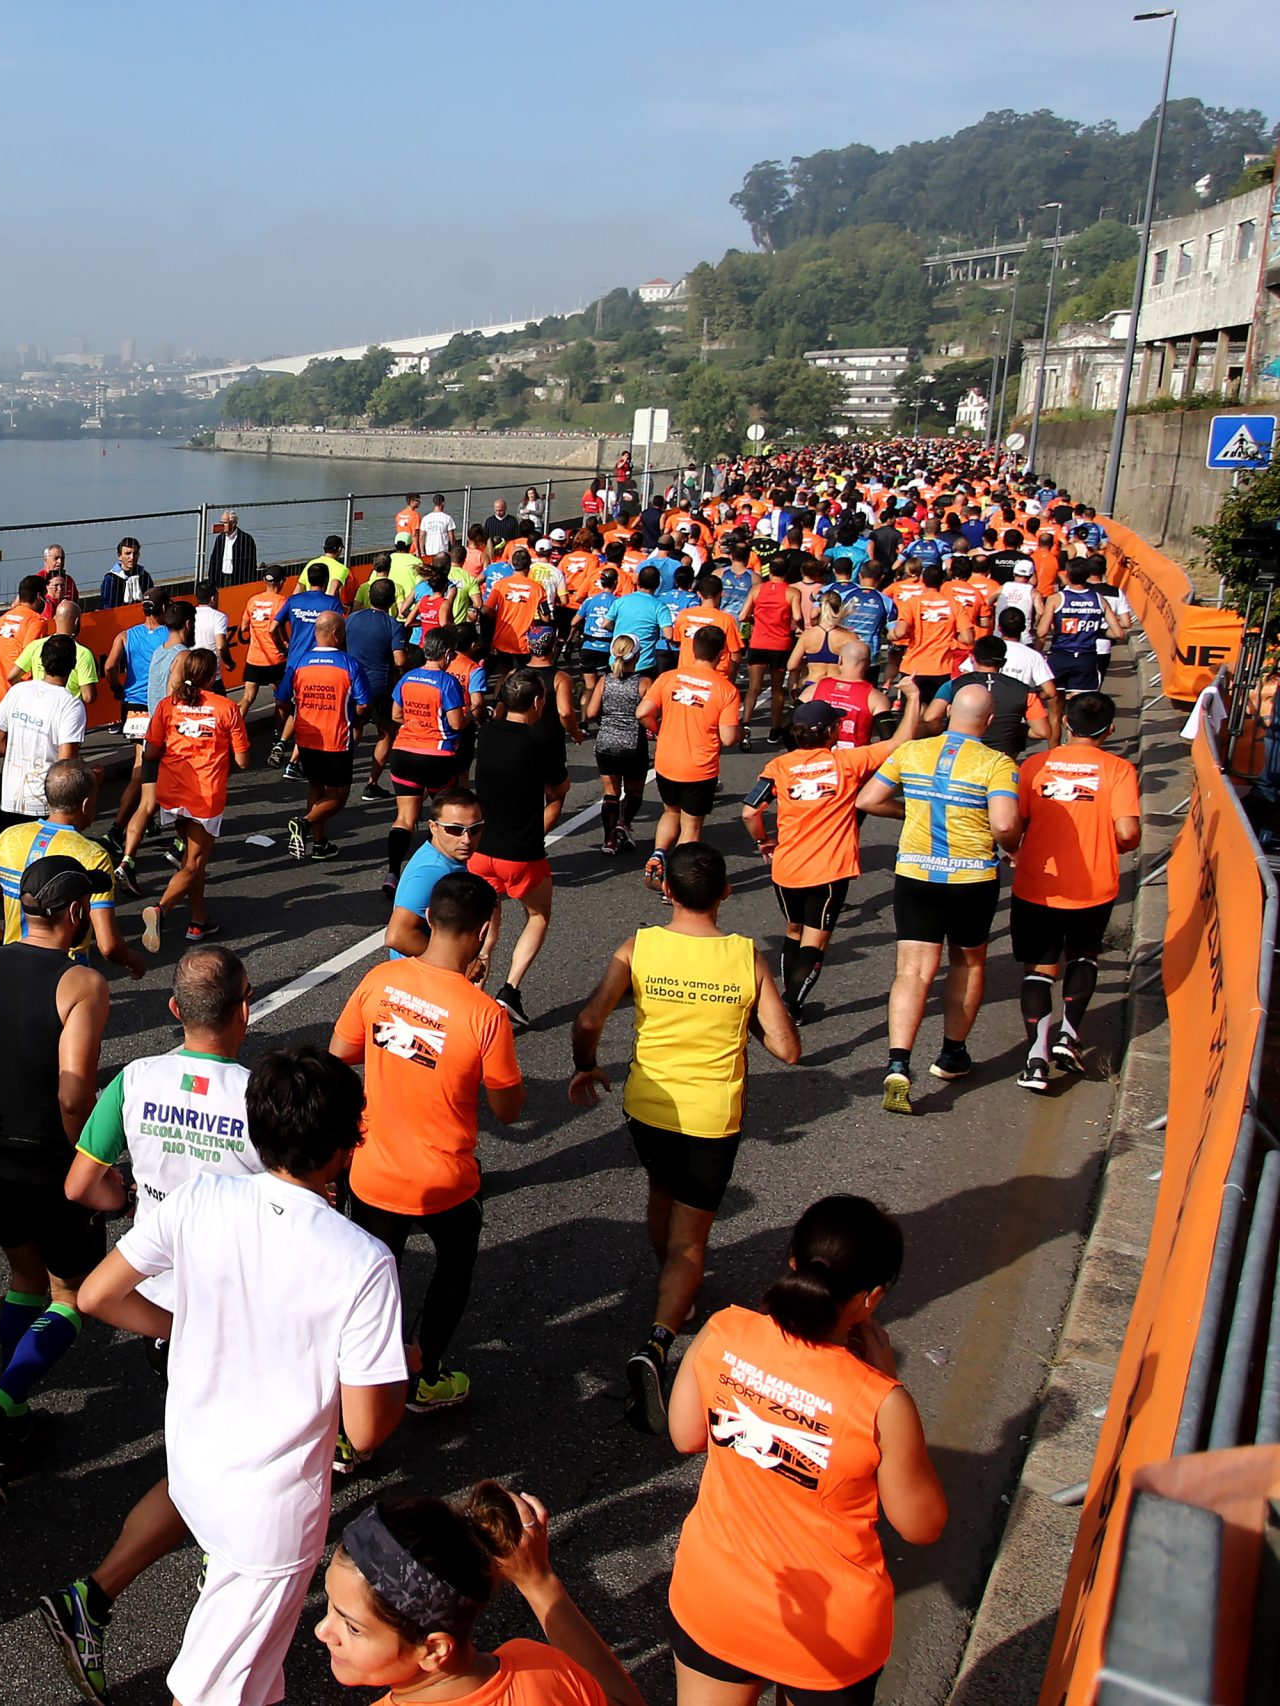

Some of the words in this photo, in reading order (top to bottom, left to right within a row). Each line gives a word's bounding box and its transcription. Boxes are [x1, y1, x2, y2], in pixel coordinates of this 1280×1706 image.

[1061, 607, 1102, 615] DESPORTIVO
[1070, 600, 1094, 608] GRUPO
[948, 858, 985, 869] FUTSAL
[645, 975, 679, 986] Juntos
[682, 980, 720, 991] vamos
[645, 985, 684, 998] Lisboa
[688, 991, 696, 1000] a
[700, 993, 741, 1005] correr!
[380, 1000, 412, 1016] SPORT
[412, 1013, 445, 1032] ZONE
[394, 988, 412, 1001] MEIA
[411, 995, 449, 1018] MARATONA
[143, 1101, 245, 1138] RUNRIVER
[140, 1122, 182, 1140] ESCOLA
[185, 1129, 245, 1153] ATLETISMO
[162, 1140, 186, 1155] RIO
[188, 1144, 221, 1163] TINTO
[722, 1350, 737, 1367] XII
[736, 1358, 765, 1380] MEIA
[765, 1374, 833, 1415] MARATONA
[730, 1366, 746, 1382] DO
[746, 1374, 787, 1404] PORTO
[786, 1396, 816, 1417] 2018
[718, 1373, 766, 1405] SPORT
[768, 1400, 830, 1436] ZONE
